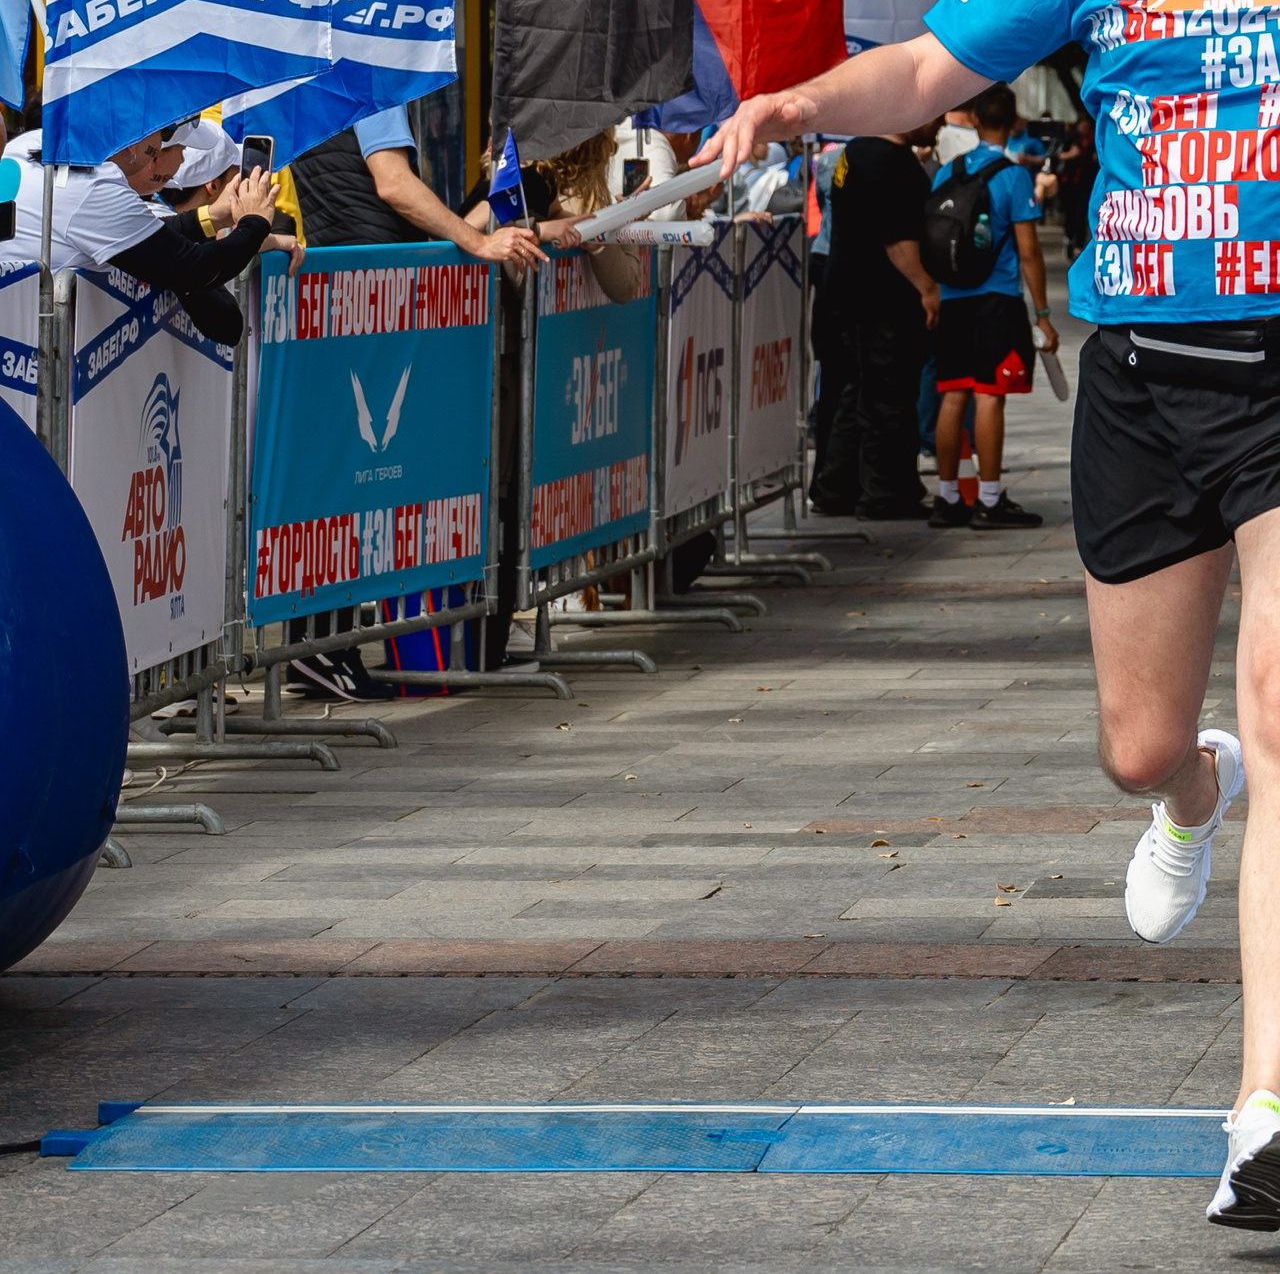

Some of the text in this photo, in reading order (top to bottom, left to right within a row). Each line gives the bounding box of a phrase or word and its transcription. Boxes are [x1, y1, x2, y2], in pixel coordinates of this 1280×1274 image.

[1096, 183, 1239, 242] #ЛЮБОВЬ
[264, 272, 330, 344] #ЗАБЕГ
[331, 266, 415, 337] #ВОСТОРГ
[415, 264, 490, 331] #МОМЕНТ
[88, 317, 140, 380] ЗАБЕГ.РФ
[694, 347, 724, 438] ПСБ
[121, 465, 166, 543] АВТО
[354, 464, 403, 485] ЛИГА ГЕРОЕВ
[133, 525, 187, 607] РАДИО
[253, 493, 483, 600] #ГОРДОСТЬ #ЗАБЕГ #МЕЧТА
